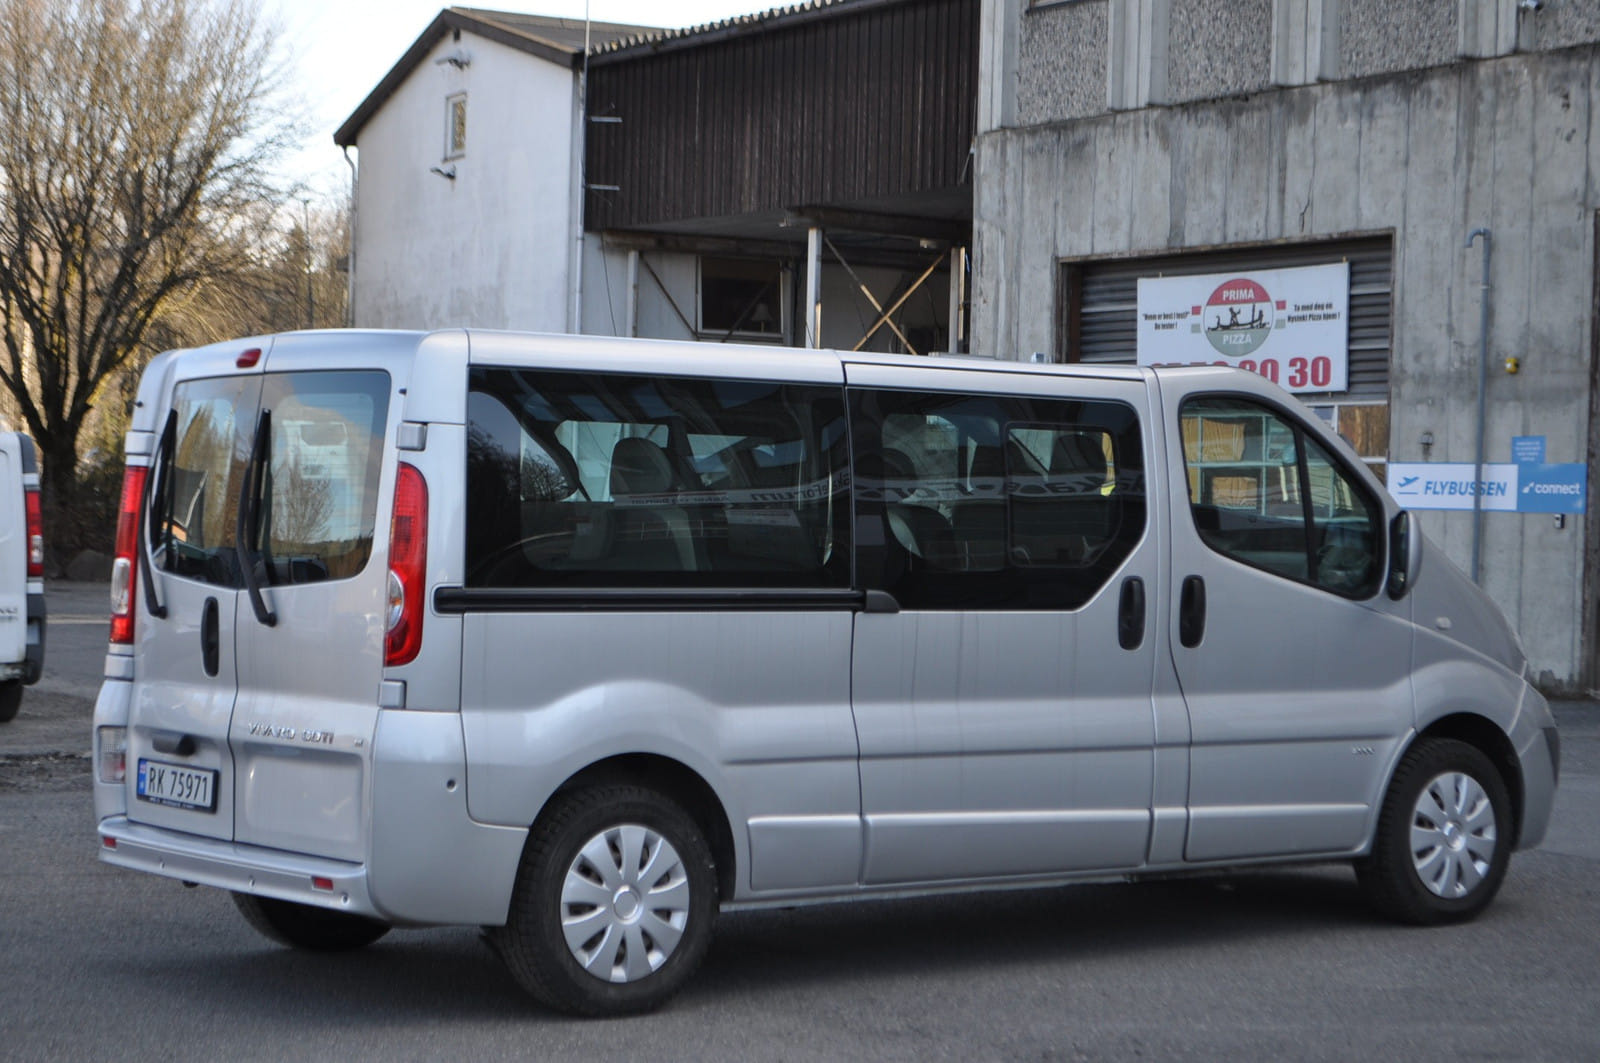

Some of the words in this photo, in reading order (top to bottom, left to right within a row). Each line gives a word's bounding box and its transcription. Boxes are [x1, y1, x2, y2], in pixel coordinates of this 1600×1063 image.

[1222, 288, 1255, 300] PRIMA
[1222, 333, 1252, 345] PIZZA
[1288, 356, 1332, 388] 30
[1424, 480, 1507, 496] FLYBUSSEN
[1534, 482, 1581, 495] connect
[148, 767, 166, 795] RK
[170, 770, 208, 803] 75971
